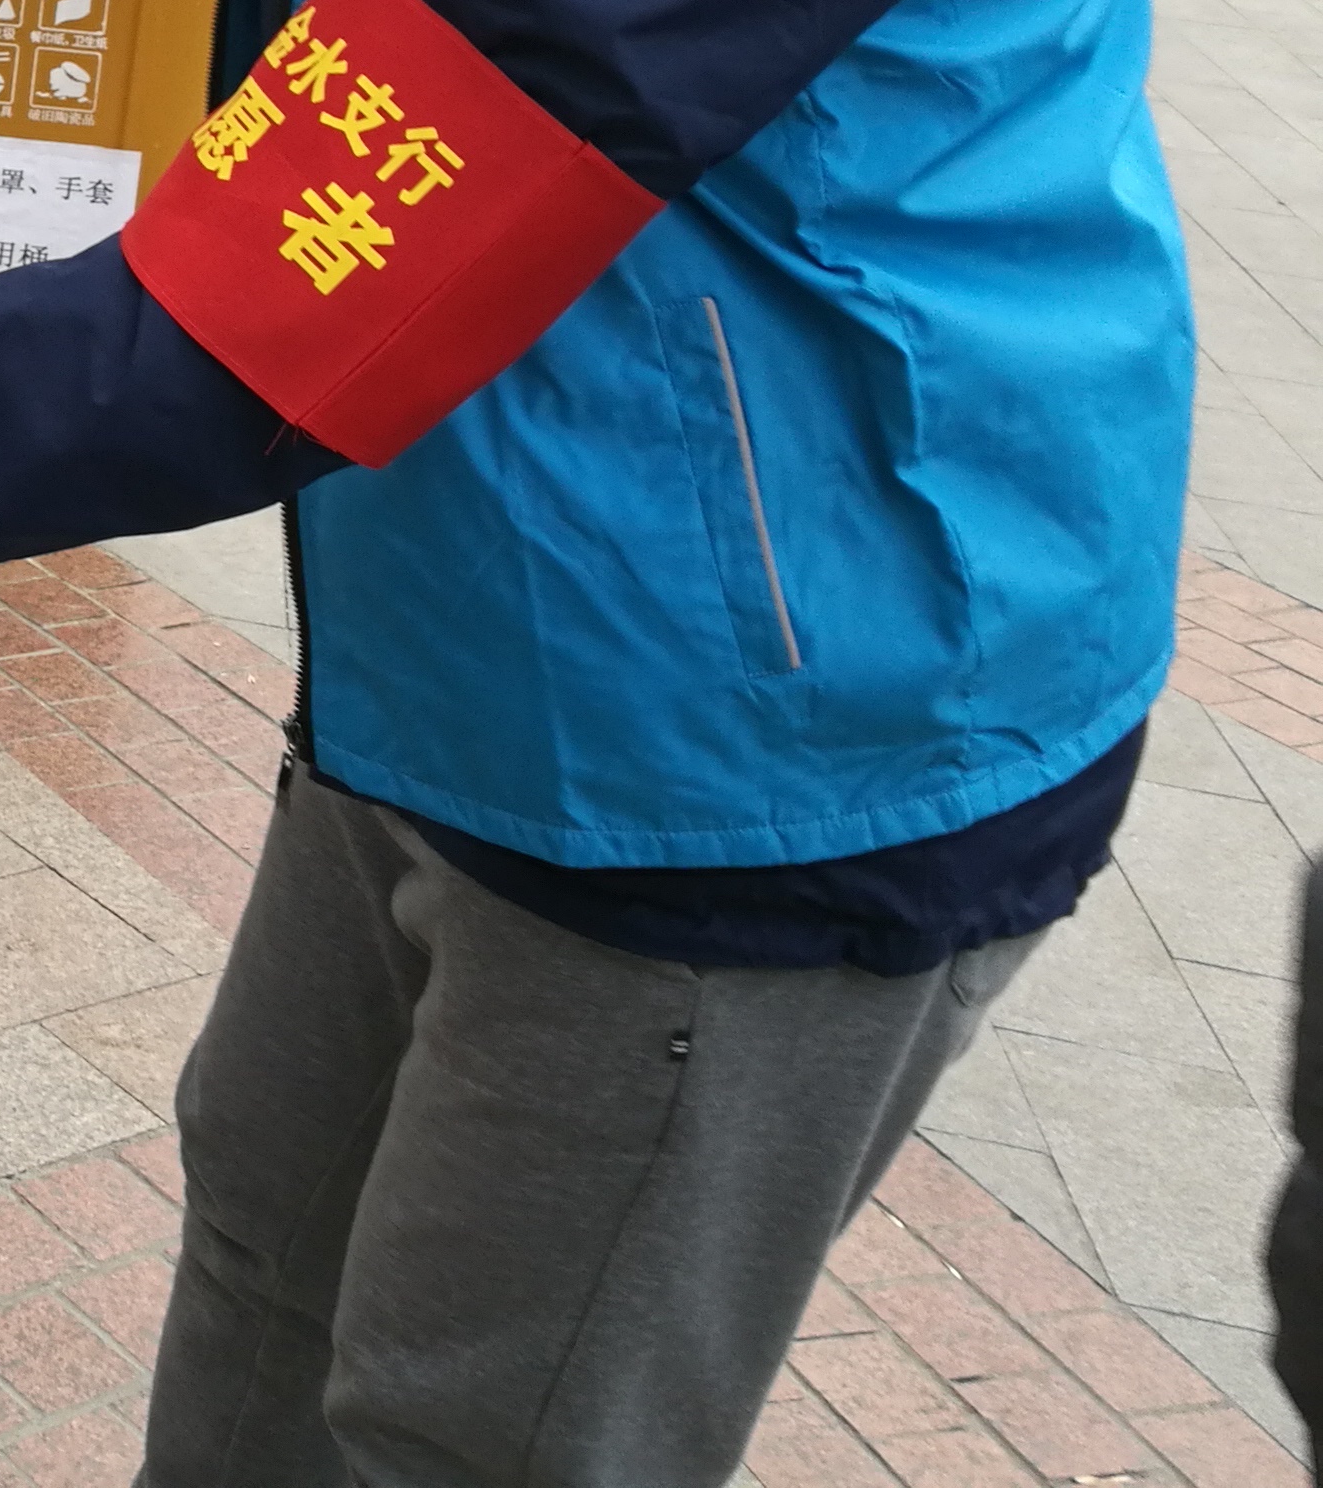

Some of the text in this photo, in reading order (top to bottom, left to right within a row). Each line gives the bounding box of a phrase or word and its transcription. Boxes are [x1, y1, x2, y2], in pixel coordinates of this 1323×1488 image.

[29, 30, 109, 51] 餐巾纸、卫生纸
[27, 108, 96, 127] 破旧陶瓷品
